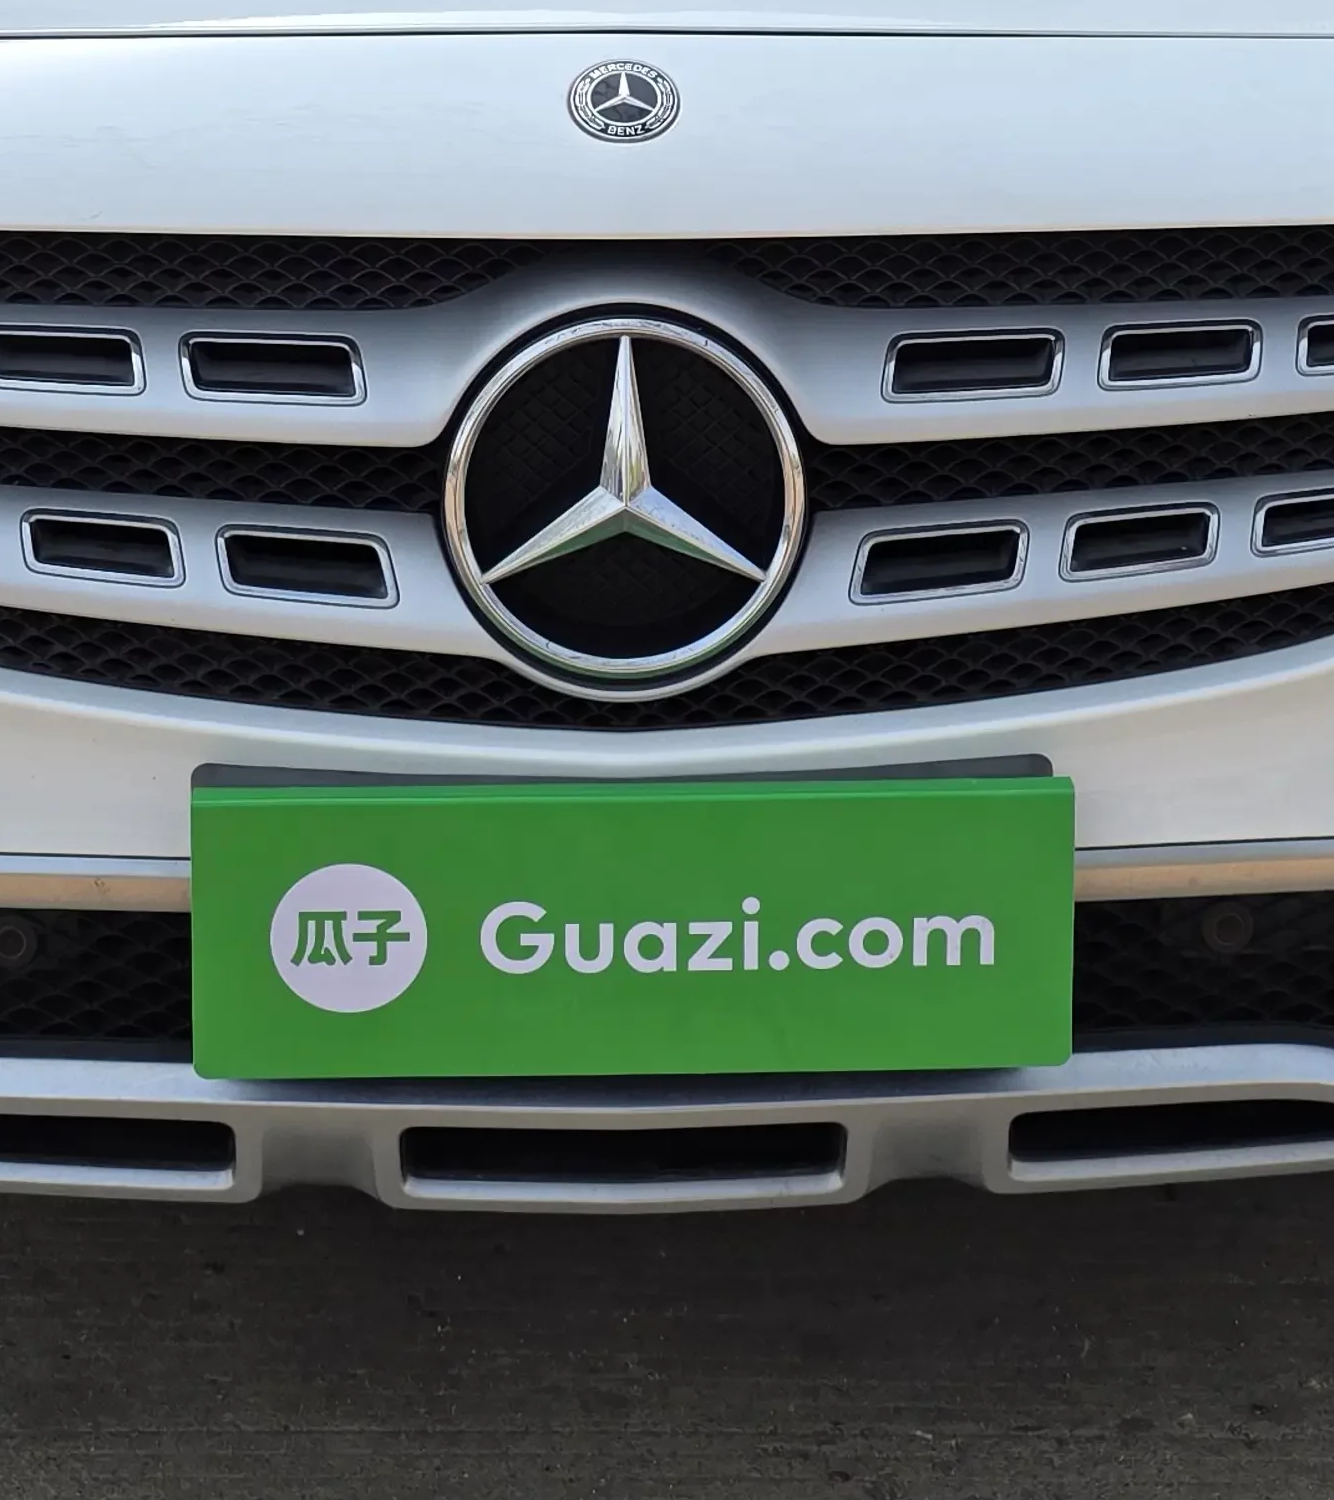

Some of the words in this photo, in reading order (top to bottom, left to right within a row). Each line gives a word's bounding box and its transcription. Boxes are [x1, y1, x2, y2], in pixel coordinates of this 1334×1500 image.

[589, 62, 658, 80] MERCEDES
[607, 124, 646, 136] BENZ
[290, 909, 411, 969] 瓜子
[479, 896, 997, 975] Guazi.com
